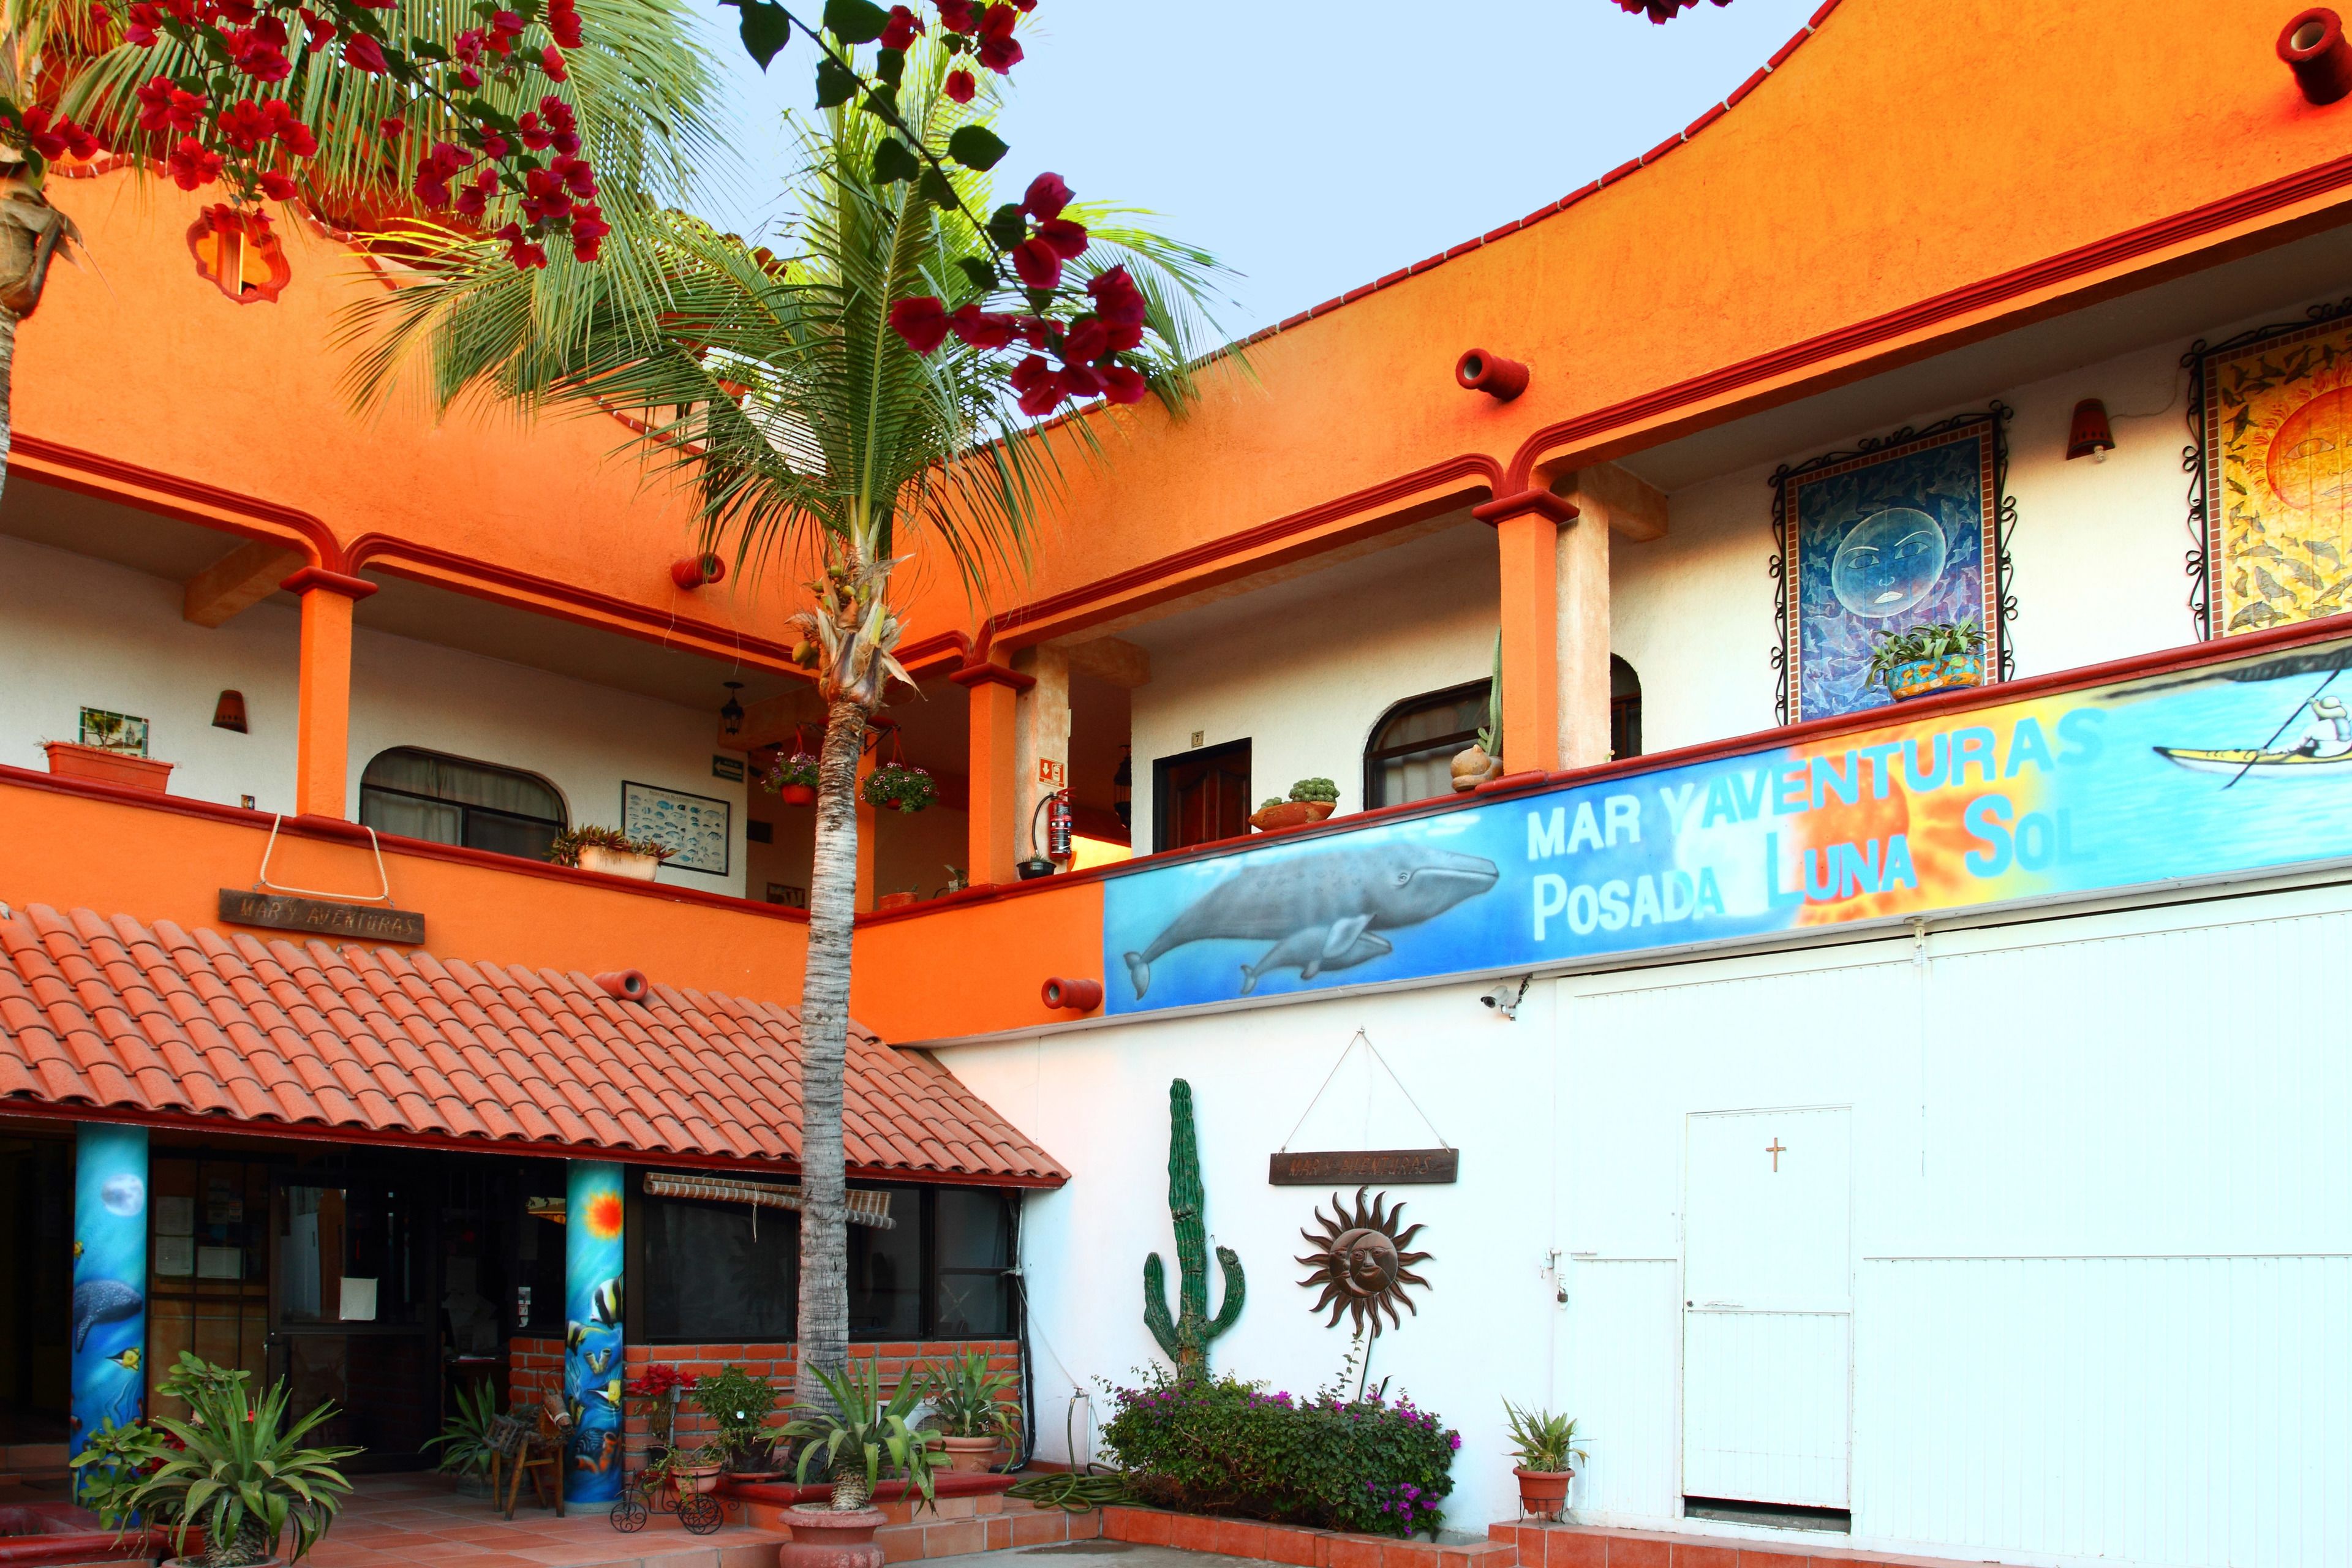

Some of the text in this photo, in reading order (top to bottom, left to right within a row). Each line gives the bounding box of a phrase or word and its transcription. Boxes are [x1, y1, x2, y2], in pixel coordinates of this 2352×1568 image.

[1527, 707, 2108, 861] MAR Y AVENTURAS
[1533, 794, 2098, 941] POSADA LUNA SOL
[241, 899, 415, 935] MAR Y AVENTURAS
[1289, 1156, 1321, 1177] MAR
[1338, 1155, 1432, 1177] AVENTURAS
